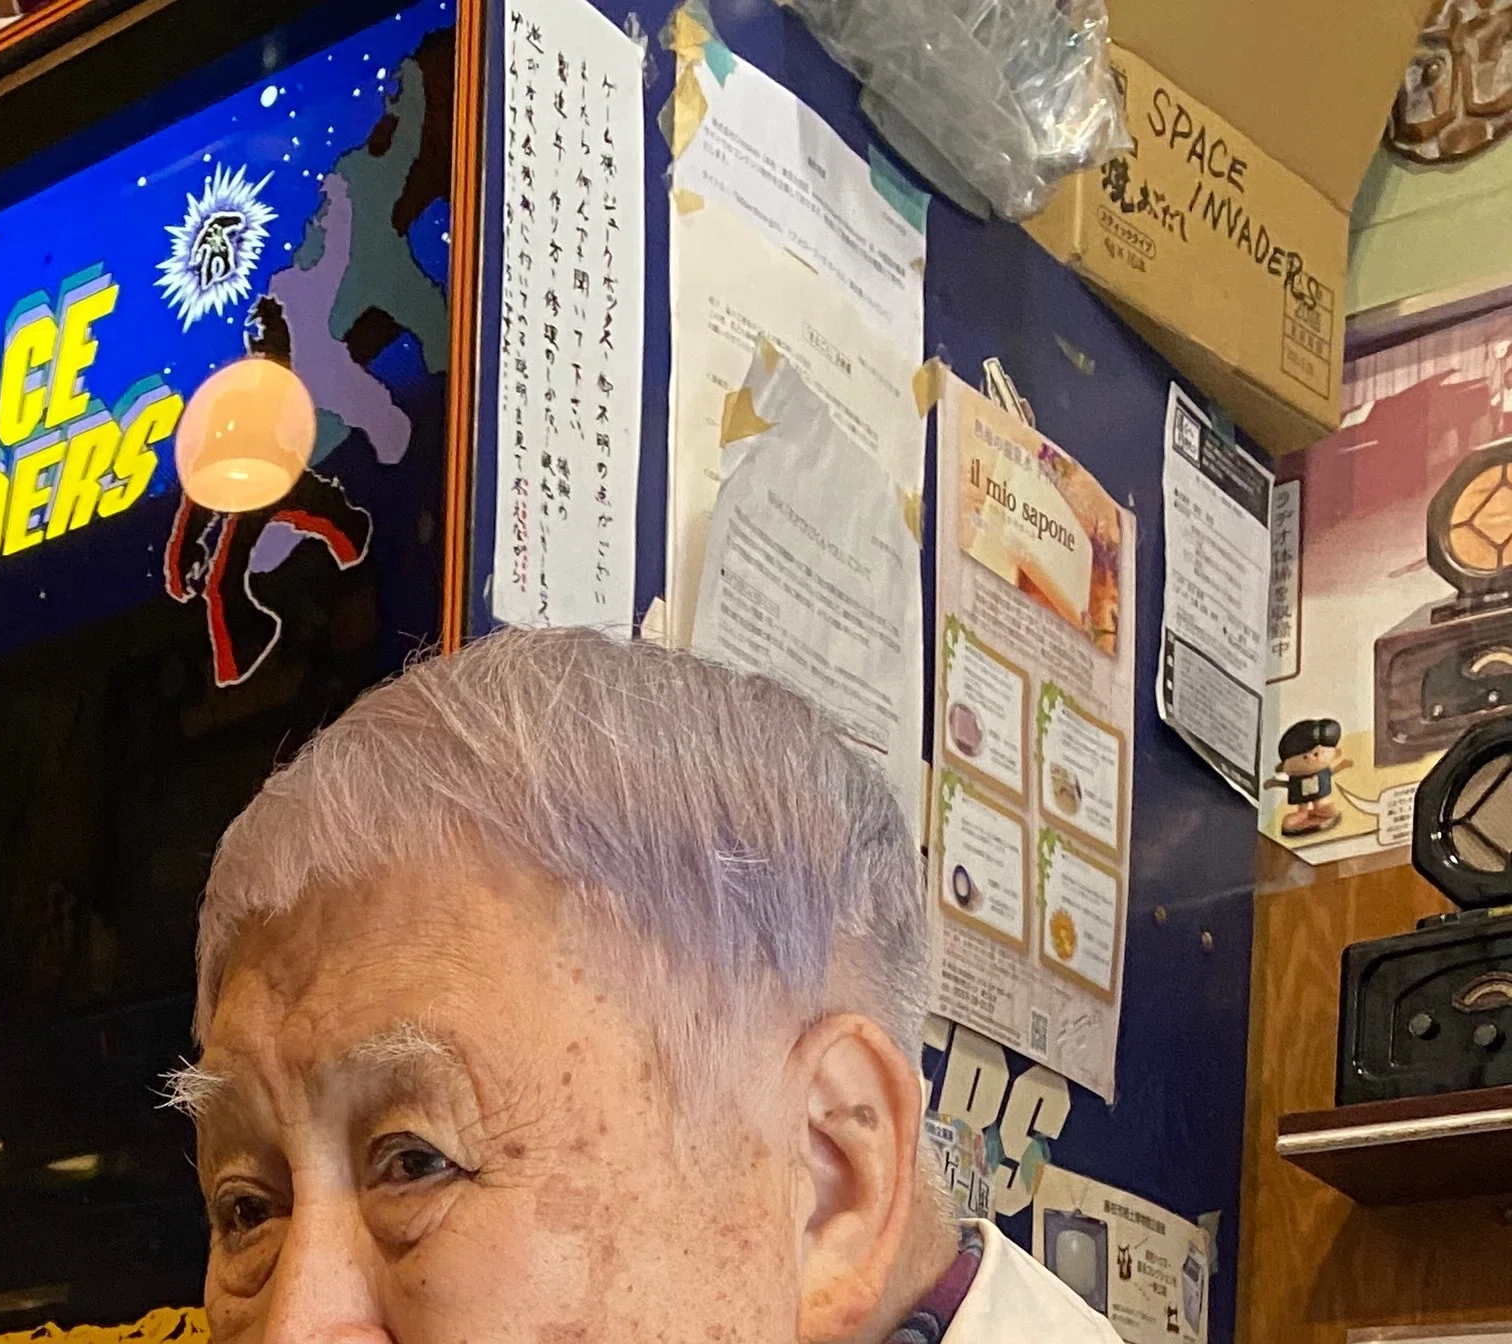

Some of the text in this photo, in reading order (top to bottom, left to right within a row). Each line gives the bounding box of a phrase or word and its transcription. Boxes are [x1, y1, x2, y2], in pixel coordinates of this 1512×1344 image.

[1147, 88, 1248, 193] SPACE
[1187, 181, 1320, 311] INVADERS
[970, 458, 1076, 553] il mio sapone
